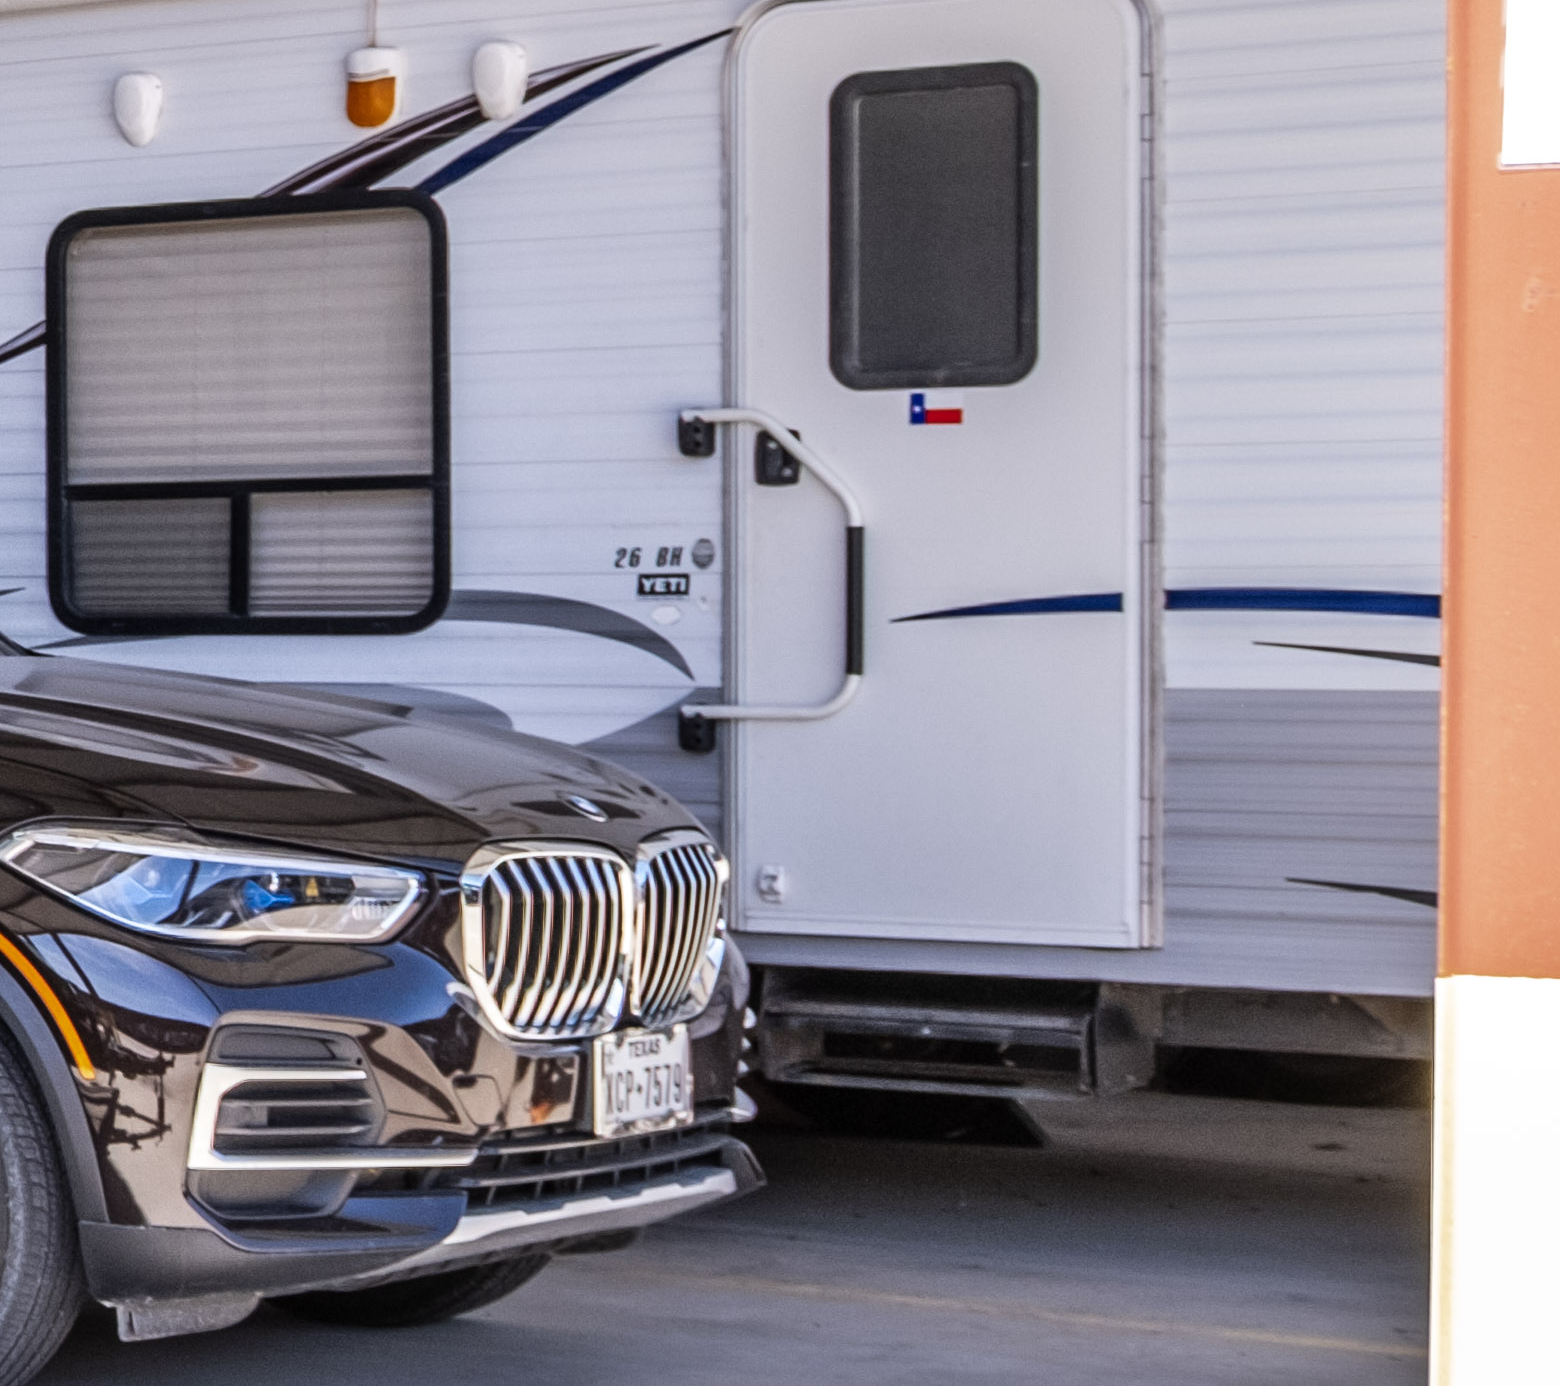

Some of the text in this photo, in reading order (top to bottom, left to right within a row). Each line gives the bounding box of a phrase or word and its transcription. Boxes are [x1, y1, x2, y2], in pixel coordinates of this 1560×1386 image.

[614, 546, 684, 568] 26 BH
[640, 577, 686, 593] YETI
[629, 1038, 661, 1059] TEXAS
